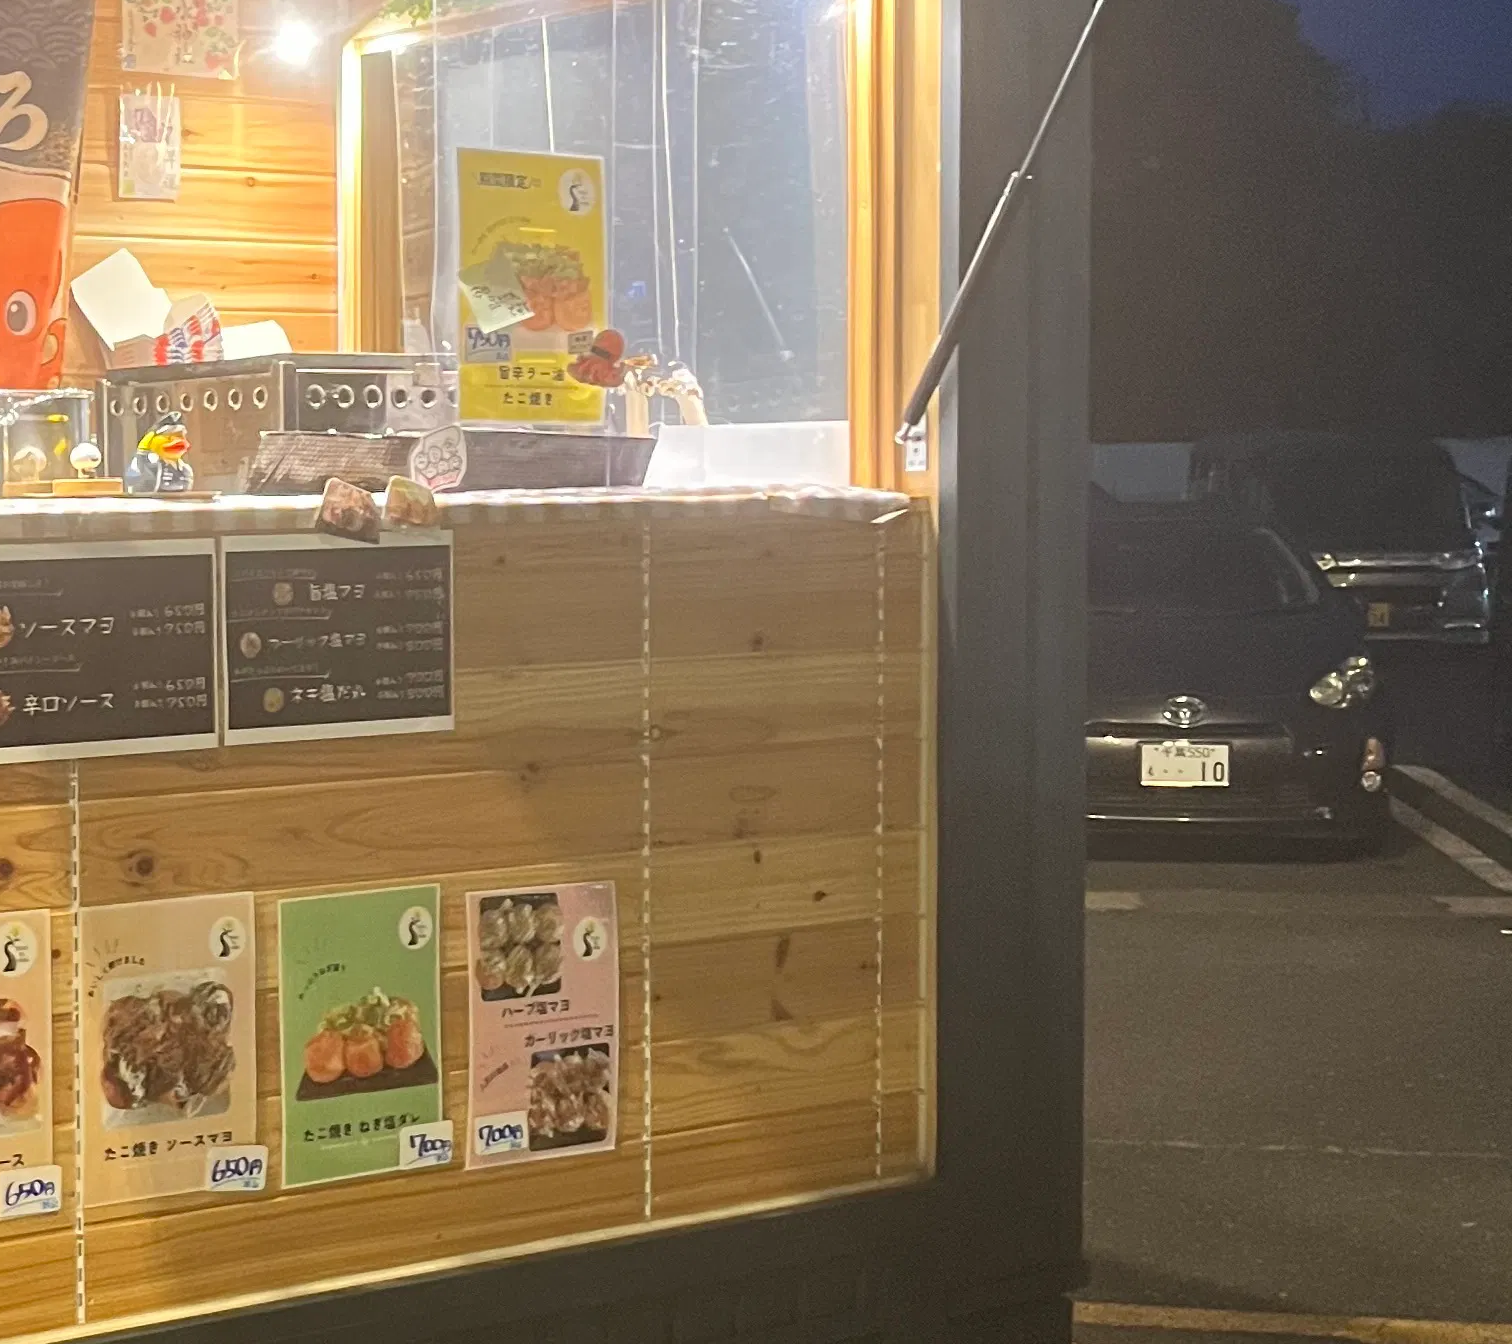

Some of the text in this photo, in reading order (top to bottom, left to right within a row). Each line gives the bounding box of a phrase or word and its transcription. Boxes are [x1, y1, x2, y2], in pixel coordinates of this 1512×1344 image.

[503, 391, 553, 406] たこ焼き
[18, 616, 115, 639] ソースマヨ
[22, 693, 115, 716] 辛口ソース
[524, 1024, 615, 1048] ガーリック塩マヨ
[304, 1122, 352, 1142] たこ焼き
[104, 1131, 233, 1161] たこ焼き ソースマヨ
[211, 1156, 263, 1183] 650円
[5, 1179, 56, 1206] 650円
